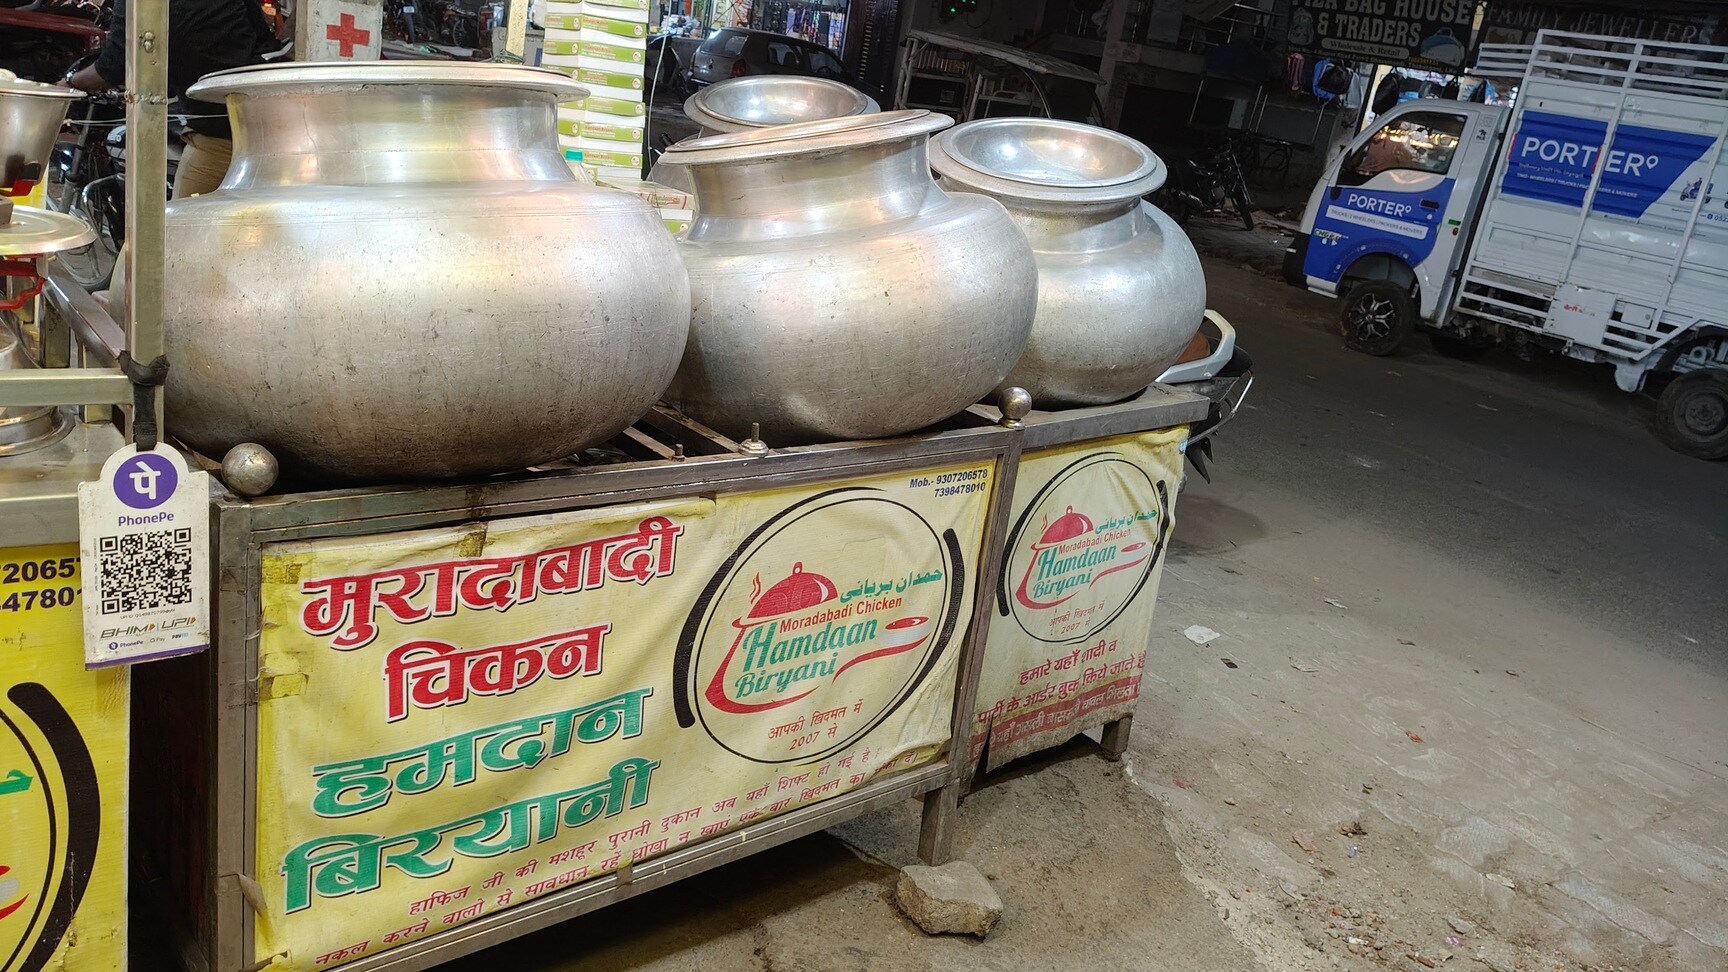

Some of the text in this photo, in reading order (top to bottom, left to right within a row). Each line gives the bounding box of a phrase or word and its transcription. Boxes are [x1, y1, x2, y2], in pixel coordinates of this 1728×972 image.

[1318, 12, 1422, 47] & TRADERS
[1345, 0, 1386, 15] BAG
[1394, 0, 1472, 25] HOUSE
[1570, 11, 1714, 44] JEWELLERS
[1330, 40, 1368, 54] Wholesale
[1370, 46, 1378, 54] &
[1379, 47, 1401, 57] Retail
[1521, 137, 1645, 177] PORTER
[1348, 194, 1405, 217] PORTER
[1714, 214, 1728, 222] 052
[129, 461, 161, 500] पे
[934, 482, 986, 498] 7398478010
[936, 469, 988, 484] 9307206578
[118, 512, 174, 526] PhonePe
[1058, 529, 1131, 555] Moradabadi Chicken
[0, 557, 81, 584] 2065
[1038, 546, 1116, 581] Hamdaan
[0, 587, 82, 612] 4780
[302, 516, 686, 651] मुरादाबादी
[1033, 569, 1092, 599] Biryani
[100, 617, 191, 638] BHIM UPI
[779, 597, 902, 634] Moradabadi Chicken
[1061, 622, 1080, 634] 2007
[742, 619, 878, 672] Hamdaan
[1020, 659, 1052, 685] हमारे
[1082, 640, 1106, 664] शादी
[1109, 640, 1118, 652] व
[384, 622, 612, 723] चिकन
[734, 652, 838, 699] Biryani
[978, 699, 1005, 724] पार्टी
[1007, 696, 1020, 712] के
[1058, 678, 1080, 700] बुक
[1082, 664, 1108, 686] किये
[1110, 654, 1135, 675] जाते
[768, 698, 864, 740] आपकी खिदमत में
[312, 687, 653, 818] हमदान
[789, 724, 838, 750] 2007 से
[279, 757, 662, 915] बिरयानी
[409, 886, 472, 916] हाफिज
[482, 871, 505, 890] जी
[516, 860, 538, 878] की
[549, 840, 598, 864] मशहूर
[608, 820, 652, 850] पुरानी
[661, 806, 702, 832] दुकान
[712, 796, 738, 812] अब
[777, 771, 811, 792] शिफ्ट
[818, 762, 830, 777] हो
[838, 751, 855, 768] गई
[315, 940, 371, 965] नकल
[383, 918, 430, 944] करने
[497, 888, 514, 906] से
[526, 864, 590, 896] सावधान
[601, 850, 622, 870] रहें
[632, 838, 668, 860] धोखा
[679, 831, 691, 843] न
[769, 797, 792, 812] बार
[799, 778, 840, 802] खिदमत
[850, 772, 866, 784] का
